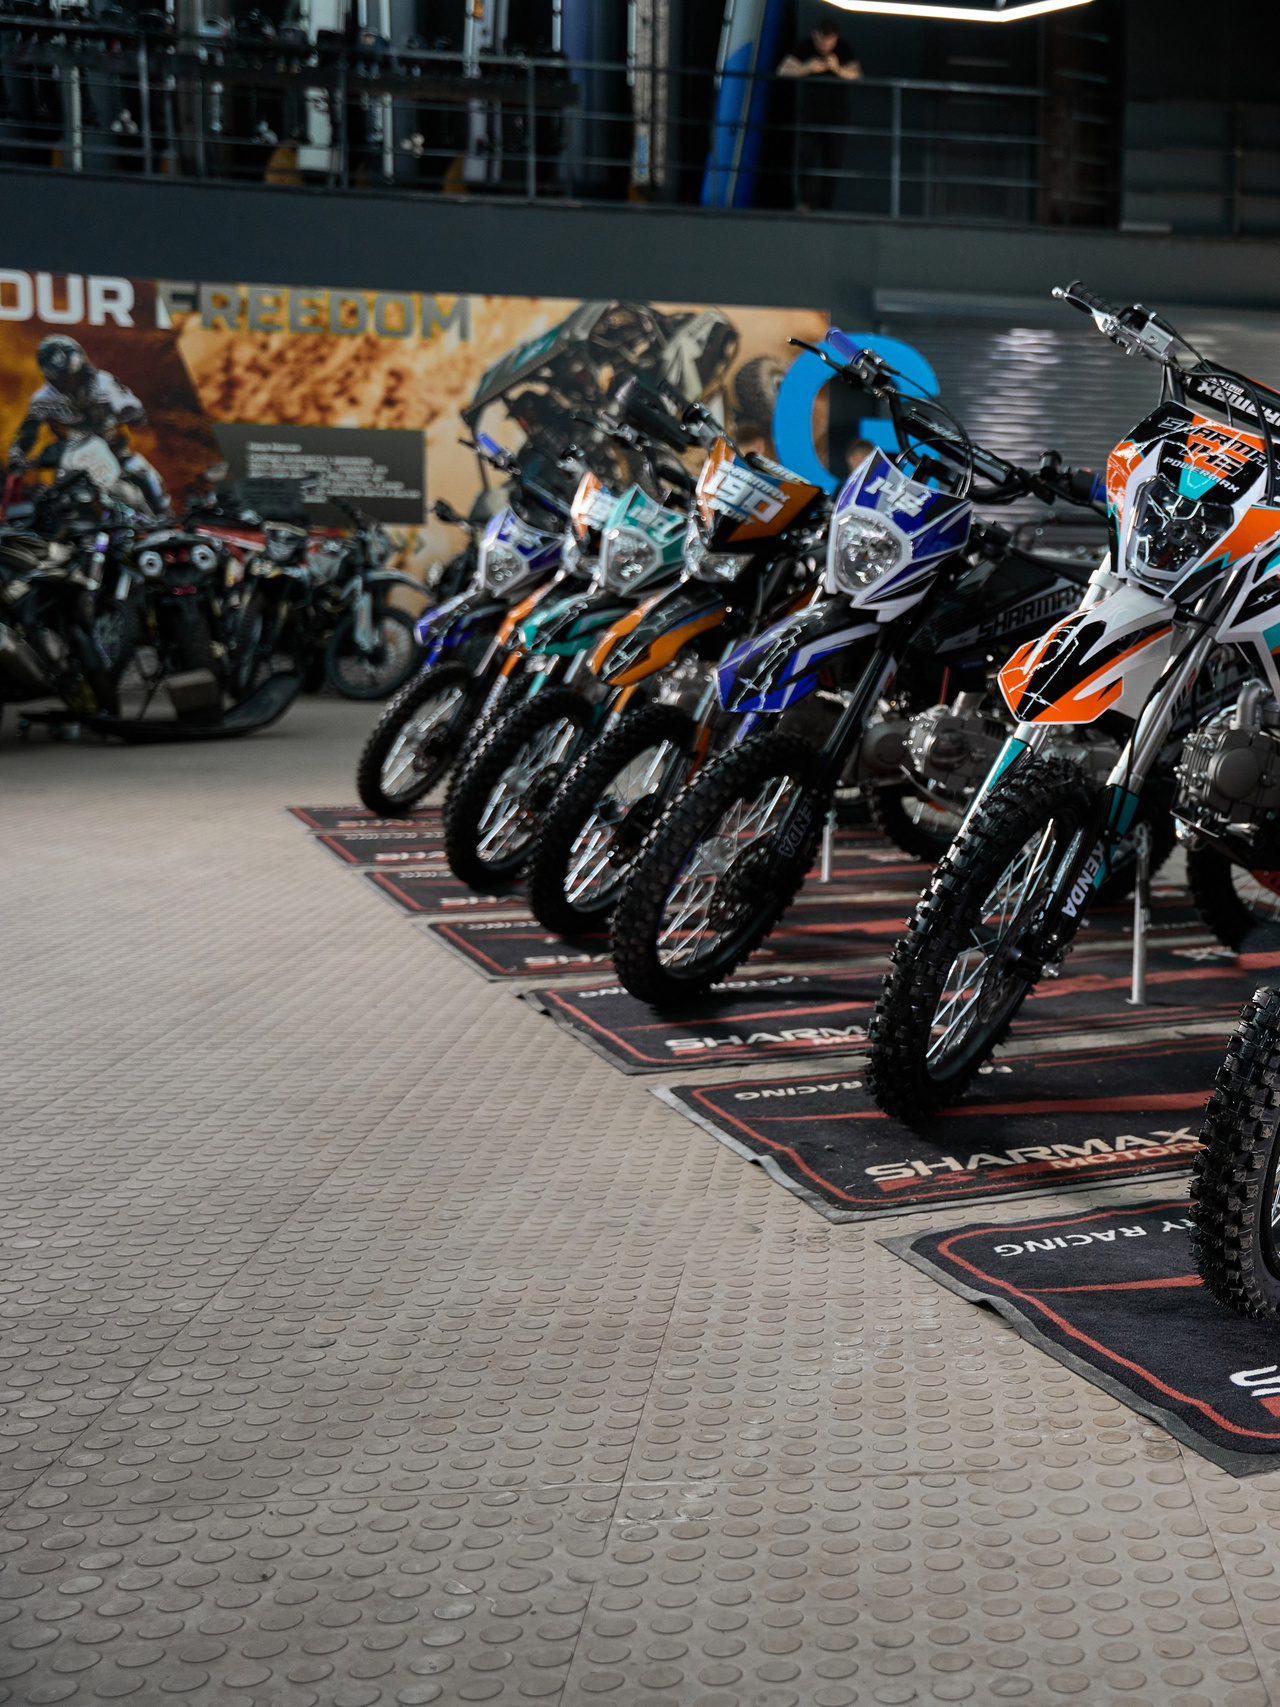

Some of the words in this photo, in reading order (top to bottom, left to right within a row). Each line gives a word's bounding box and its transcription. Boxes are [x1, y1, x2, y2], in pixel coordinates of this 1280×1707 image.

[156, 280, 470, 341] FREEDOM
[1163, 457, 1240, 493] POWERMAX
[1180, 441, 1243, 476] 145
[703, 469, 784, 523] 190
[864, 476, 930, 517] 145
[979, 585, 1084, 637] SHARMAX
[664, 1025, 868, 1050] SHARM
[734, 1080, 863, 1101] RACING
[865, 1126, 1199, 1183] SHARMAX
[994, 1225, 1148, 1257] RACING
